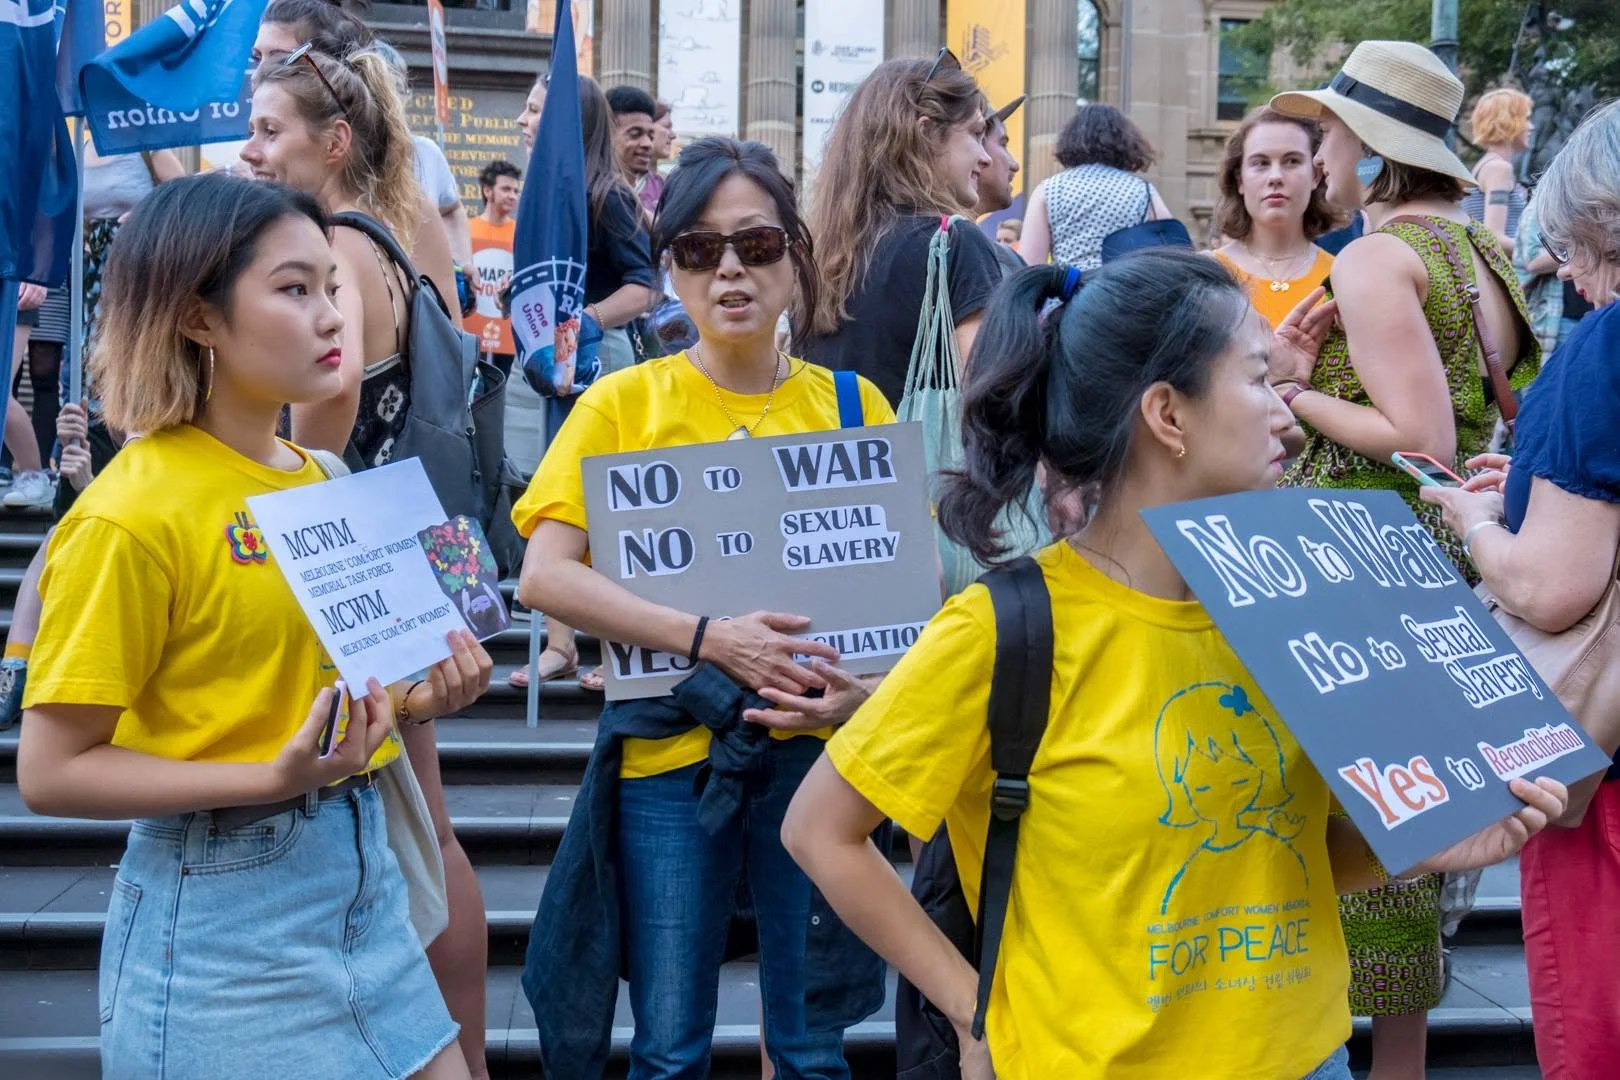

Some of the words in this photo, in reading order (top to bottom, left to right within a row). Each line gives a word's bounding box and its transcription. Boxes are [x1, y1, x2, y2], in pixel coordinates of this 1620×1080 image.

[465, 132, 520, 146] MEMORY
[522, 303, 541, 339] Union
[534, 302, 549, 328] One
[609, 463, 679, 510] NO
[706, 467, 741, 491] TO
[777, 439, 893, 488] WAR
[281, 518, 357, 560] MCWM
[624, 527, 694, 575] NO
[718, 532, 752, 555] TO
[783, 506, 881, 535] SEXUAL
[787, 535, 896, 568] SLAVERY
[1181, 517, 1306, 605] No
[1302, 537, 1354, 583] to
[1308, 499, 1457, 588] War
[300, 560, 347, 583] MELBOURNE
[308, 579, 348, 599] MEMORIAL
[345, 571, 369, 586] TASK
[367, 561, 395, 580] FORCE
[320, 589, 391, 636] MCWM
[339, 633, 381, 658] MELBOURNE
[379, 617, 417, 641] 'COMORT
[1289, 634, 1367, 693] No
[1366, 639, 1405, 668] to
[1402, 608, 1494, 661] Sexual
[1446, 655, 1543, 708] Slavery
[1341, 761, 1447, 826] Yes
[1445, 758, 1484, 791] to
[1482, 725, 1583, 777] Reconciliation
[1147, 915, 1199, 934] MELBOURNE
[1244, 903, 1278, 915] WOMEN
[1150, 935, 1210, 981] FOR
[1217, 918, 1310, 962] PEACE
